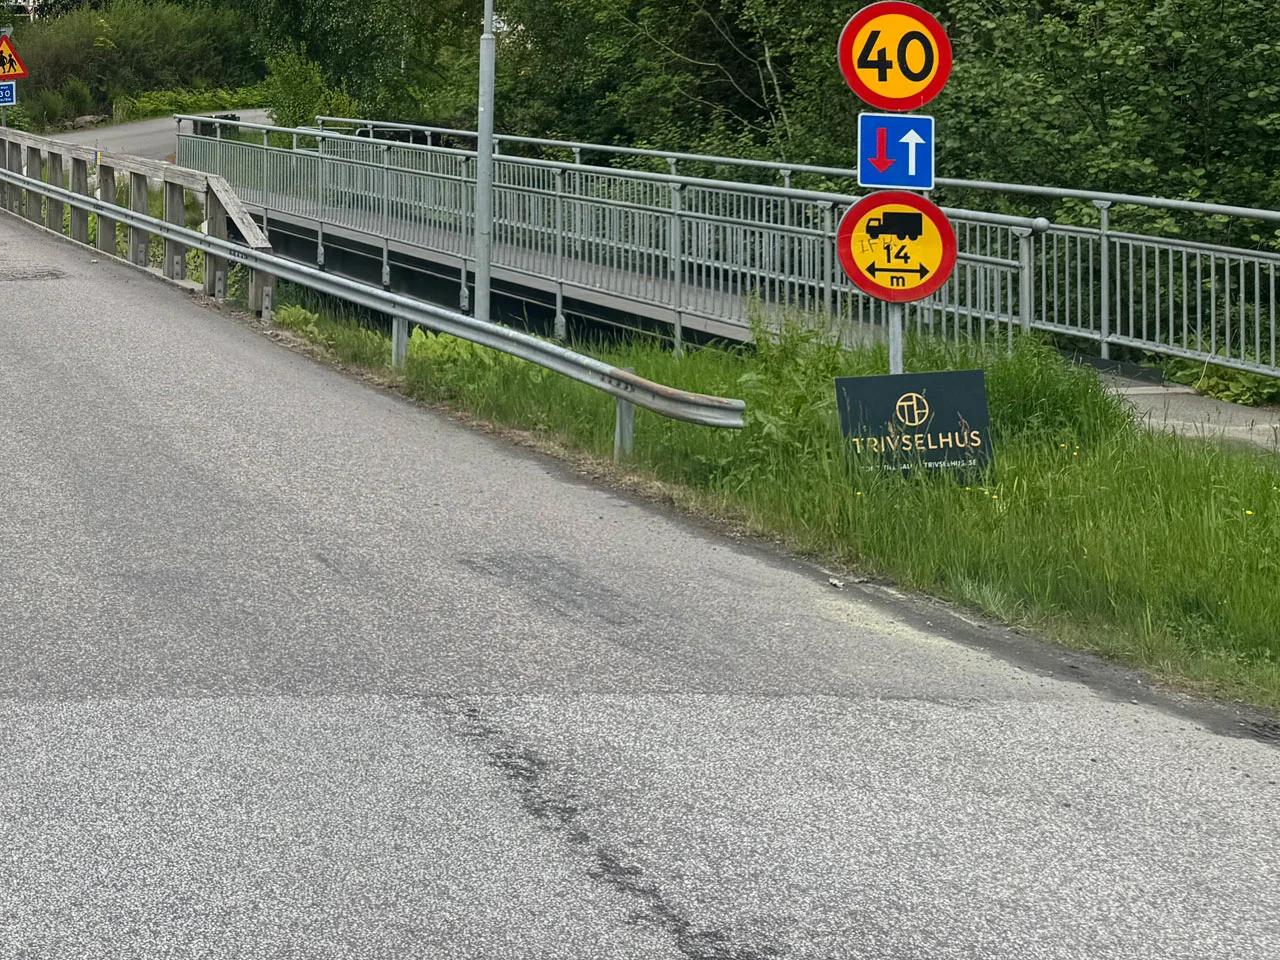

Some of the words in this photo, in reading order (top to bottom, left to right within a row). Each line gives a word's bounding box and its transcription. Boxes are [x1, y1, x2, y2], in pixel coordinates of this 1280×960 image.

[857, 30, 934, 82] 40
[883, 244, 911, 264] 14
[890, 275, 906, 287] m
[852, 430, 982, 454] TRIVSELHUS
